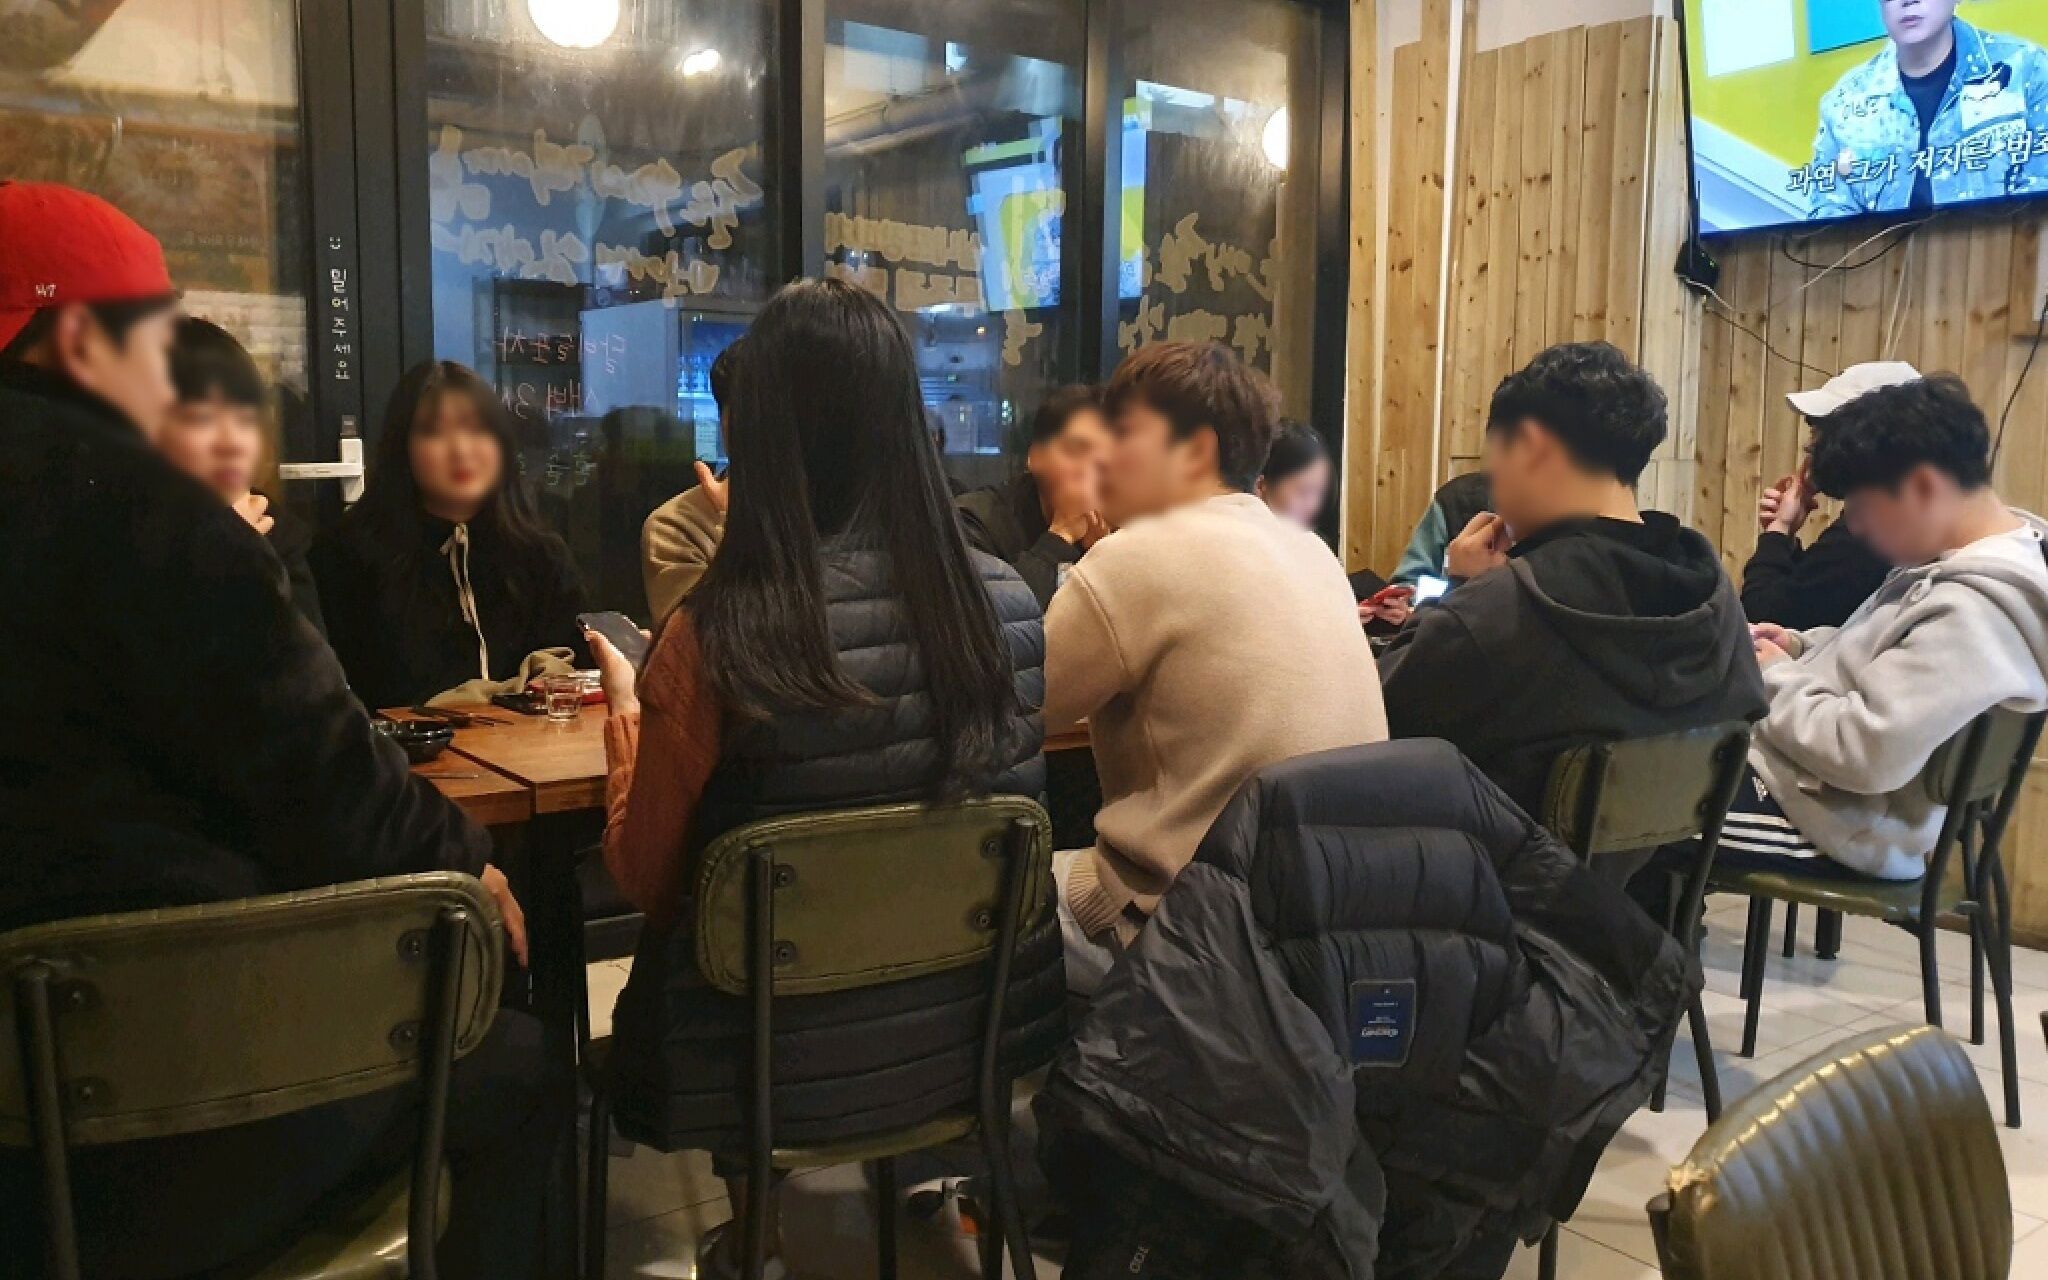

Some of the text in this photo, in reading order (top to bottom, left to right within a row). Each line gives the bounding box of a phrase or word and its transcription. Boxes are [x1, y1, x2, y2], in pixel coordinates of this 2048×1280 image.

[1786, 162, 1837, 195] 과연
[1846, 154, 1898, 183] 그가
[1907, 136, 1992, 177] 저지른
[329, 267, 352, 381] 밀어주세요
